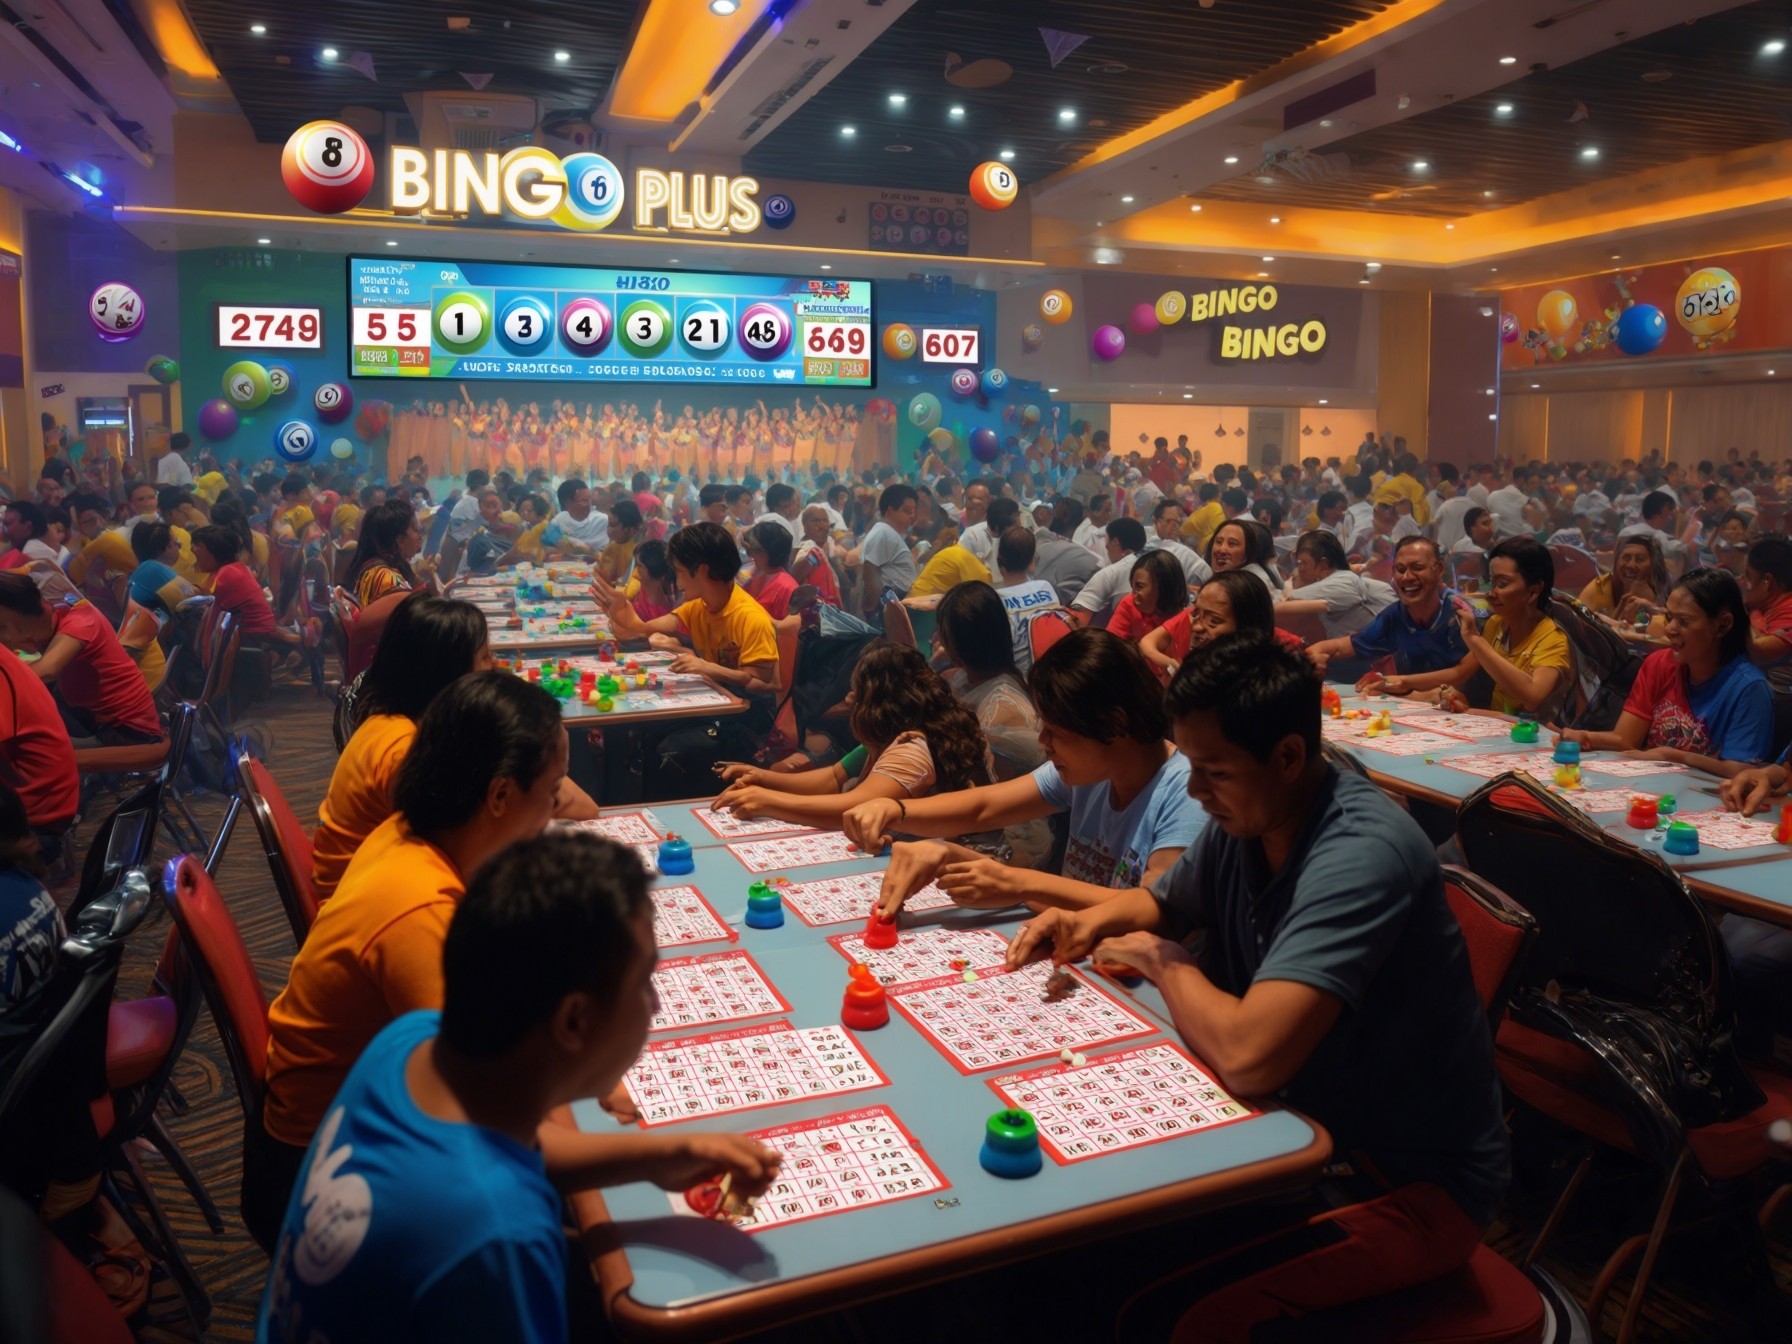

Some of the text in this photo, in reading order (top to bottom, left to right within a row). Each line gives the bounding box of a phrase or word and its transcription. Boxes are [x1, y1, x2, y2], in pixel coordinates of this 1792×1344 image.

[322, 137, 343, 168] 8
[636, 168, 761, 234] PLUS
[1191, 285, 1278, 322] BINGO
[231, 313, 318, 342] 2749
[454, 312, 465, 336] 1
[518, 315, 532, 338] 3
[575, 315, 593, 338] 4
[635, 316, 653, 340] 3
[687, 317, 720, 344] 21
[807, 325, 866, 355] 669
[1221, 320, 1327, 360] BINGO
[925, 333, 976, 358] 607
